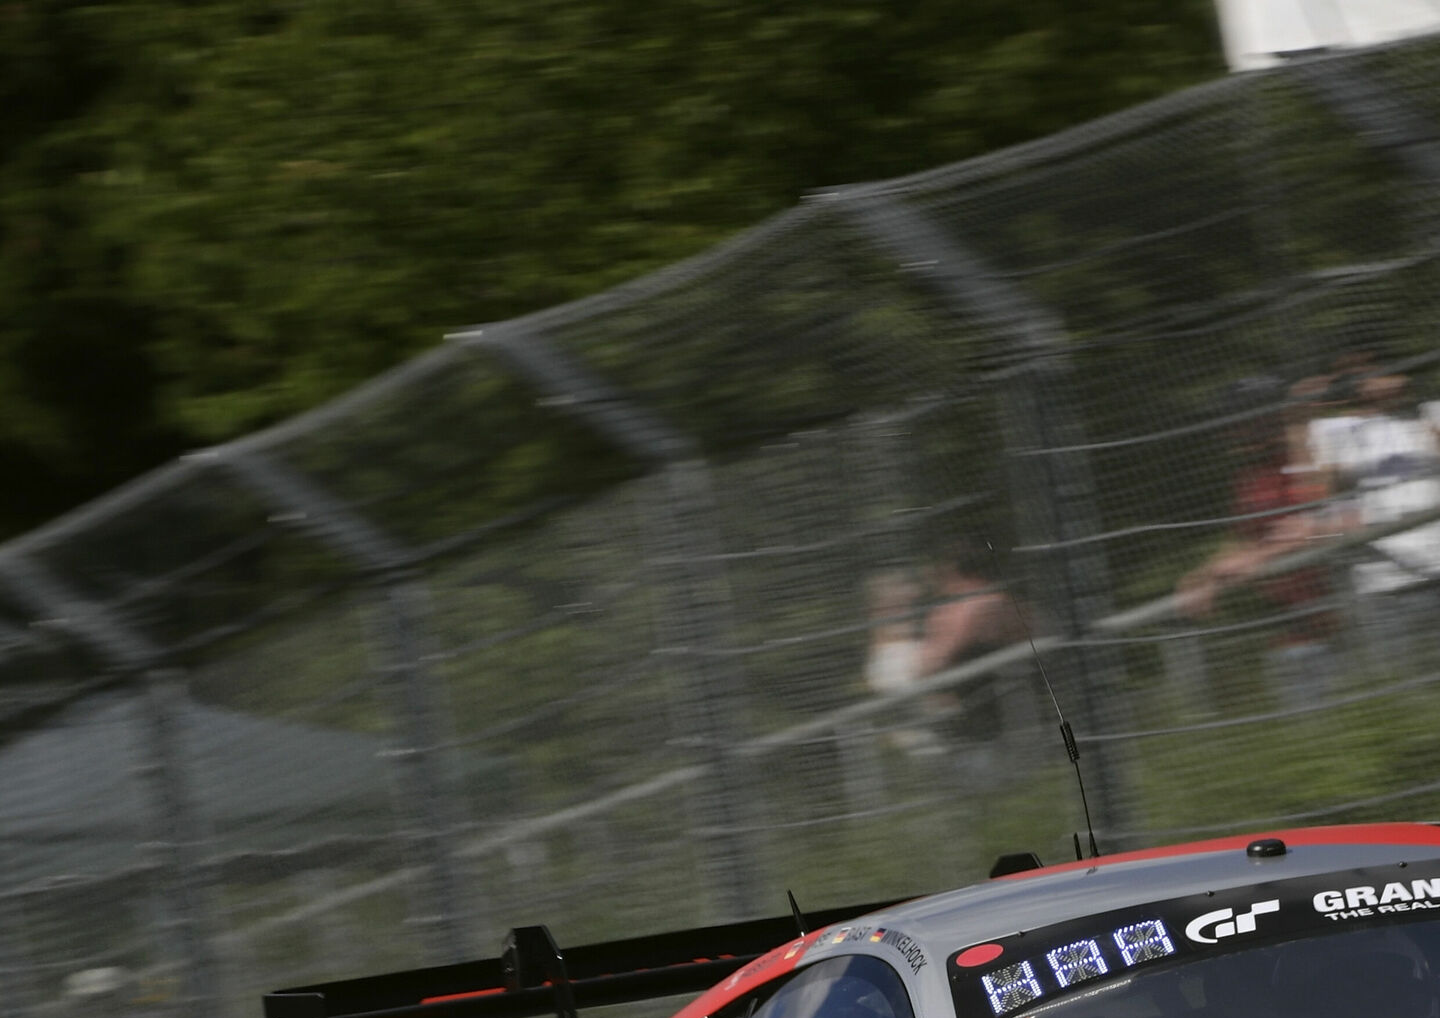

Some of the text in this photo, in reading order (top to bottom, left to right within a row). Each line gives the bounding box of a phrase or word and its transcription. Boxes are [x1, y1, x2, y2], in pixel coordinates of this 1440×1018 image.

[1324, 907, 1374, 921] THE
[1377, 900, 1440, 914] REAL
[880, 928, 927, 976] WINKELHOCK
